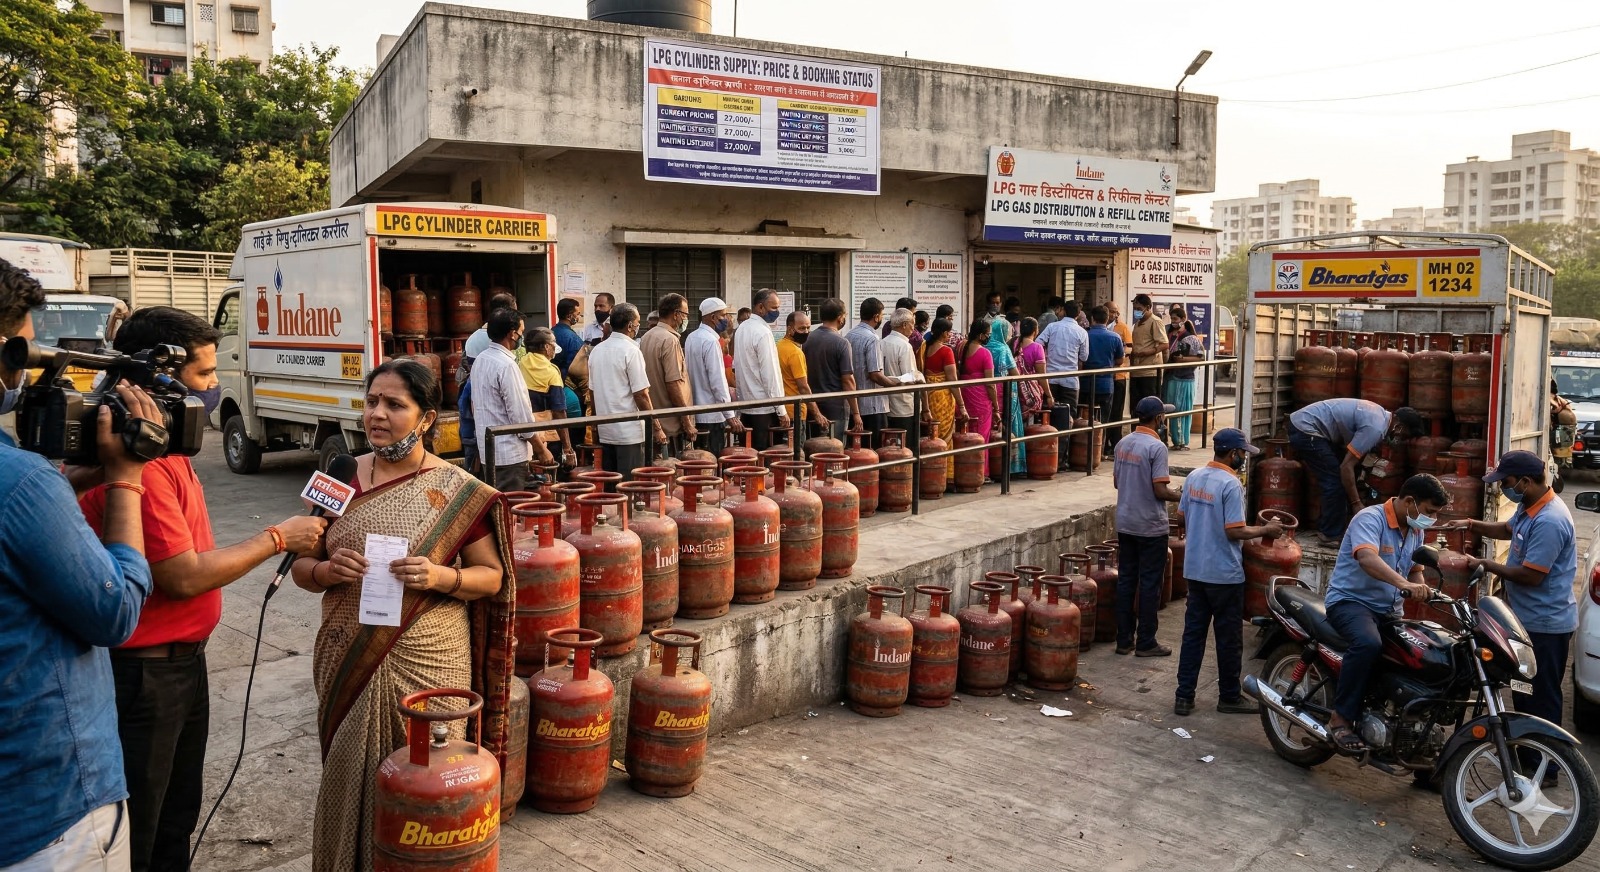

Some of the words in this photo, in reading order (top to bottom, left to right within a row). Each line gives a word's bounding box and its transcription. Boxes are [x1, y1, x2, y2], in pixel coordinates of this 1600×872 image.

[653, 47, 671, 65] LPG
[675, 50, 720, 71] CYLINDER
[723, 56, 761, 75] SUPPLY:
[763, 61, 790, 79] PRICE
[793, 65, 799, 80] &
[802, 66, 840, 84] BOOKING
[843, 70, 873, 88] STATUS
[994, 181, 1016, 195] LPG
[1097, 190, 1105, 202] &
[991, 199, 1010, 213] LPG
[1012, 200, 1031, 214] GAS
[1033, 202, 1096, 218] DISTRIBUTION
[1098, 206, 1104, 219] &
[1107, 207, 1136, 221] REFILL
[1138, 209, 1170, 223] CENTRE
[383, 213, 411, 231] LPG
[415, 215, 482, 235] CYLINDER
[486, 219, 540, 237] CARRIER
[928, 256, 958, 270] Indane
[1130, 259, 1145, 271] LPG
[1146, 260, 1162, 272] GAS
[1163, 261, 1213, 274] DISTRIBUTION
[1428, 262, 1452, 275] MH
[1456, 262, 1475, 275] 02
[1141, 273, 1147, 284] &
[1149, 273, 1174, 285] REFILL
[1175, 274, 1203, 286] CENTRE
[1308, 266, 1409, 289] Bharatgas
[1428, 277, 1473, 292] 1234
[275, 292, 342, 337] Indane
[308, 487, 341, 510] NEWS
[960, 634, 995, 651] ndane
[399, 808, 501, 846] Bharatga
